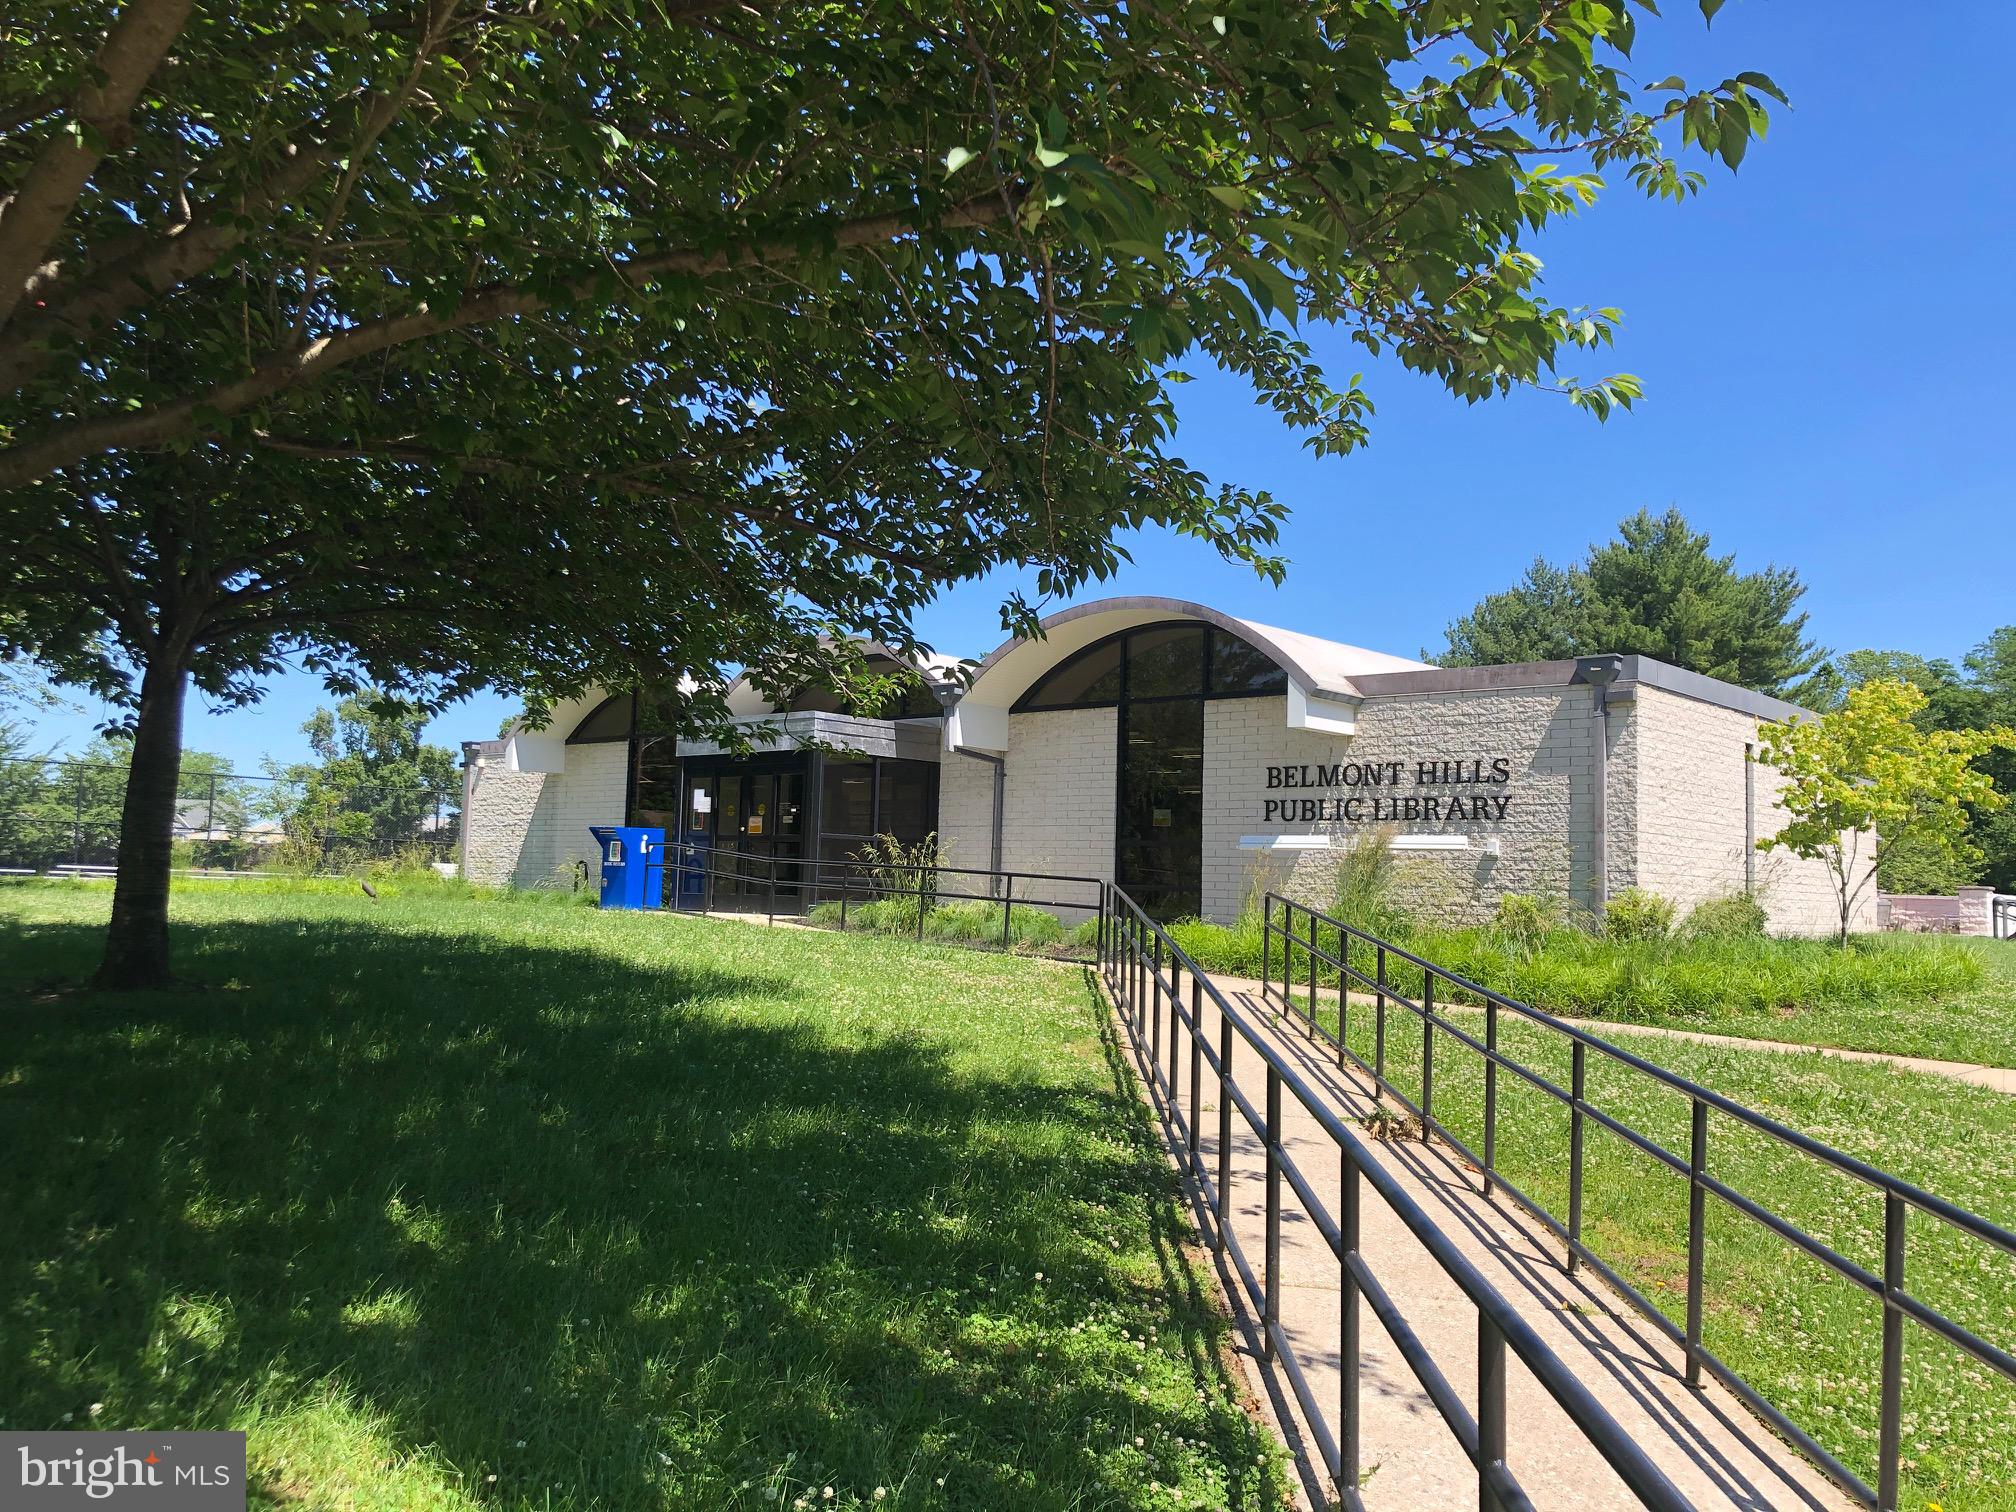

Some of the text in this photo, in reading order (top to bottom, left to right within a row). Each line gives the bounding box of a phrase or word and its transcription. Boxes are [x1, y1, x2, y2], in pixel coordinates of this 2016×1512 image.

[1266, 758, 1511, 789] BELMONT HILLS
[1263, 796, 1513, 822] PUBLIC LIBRARY
